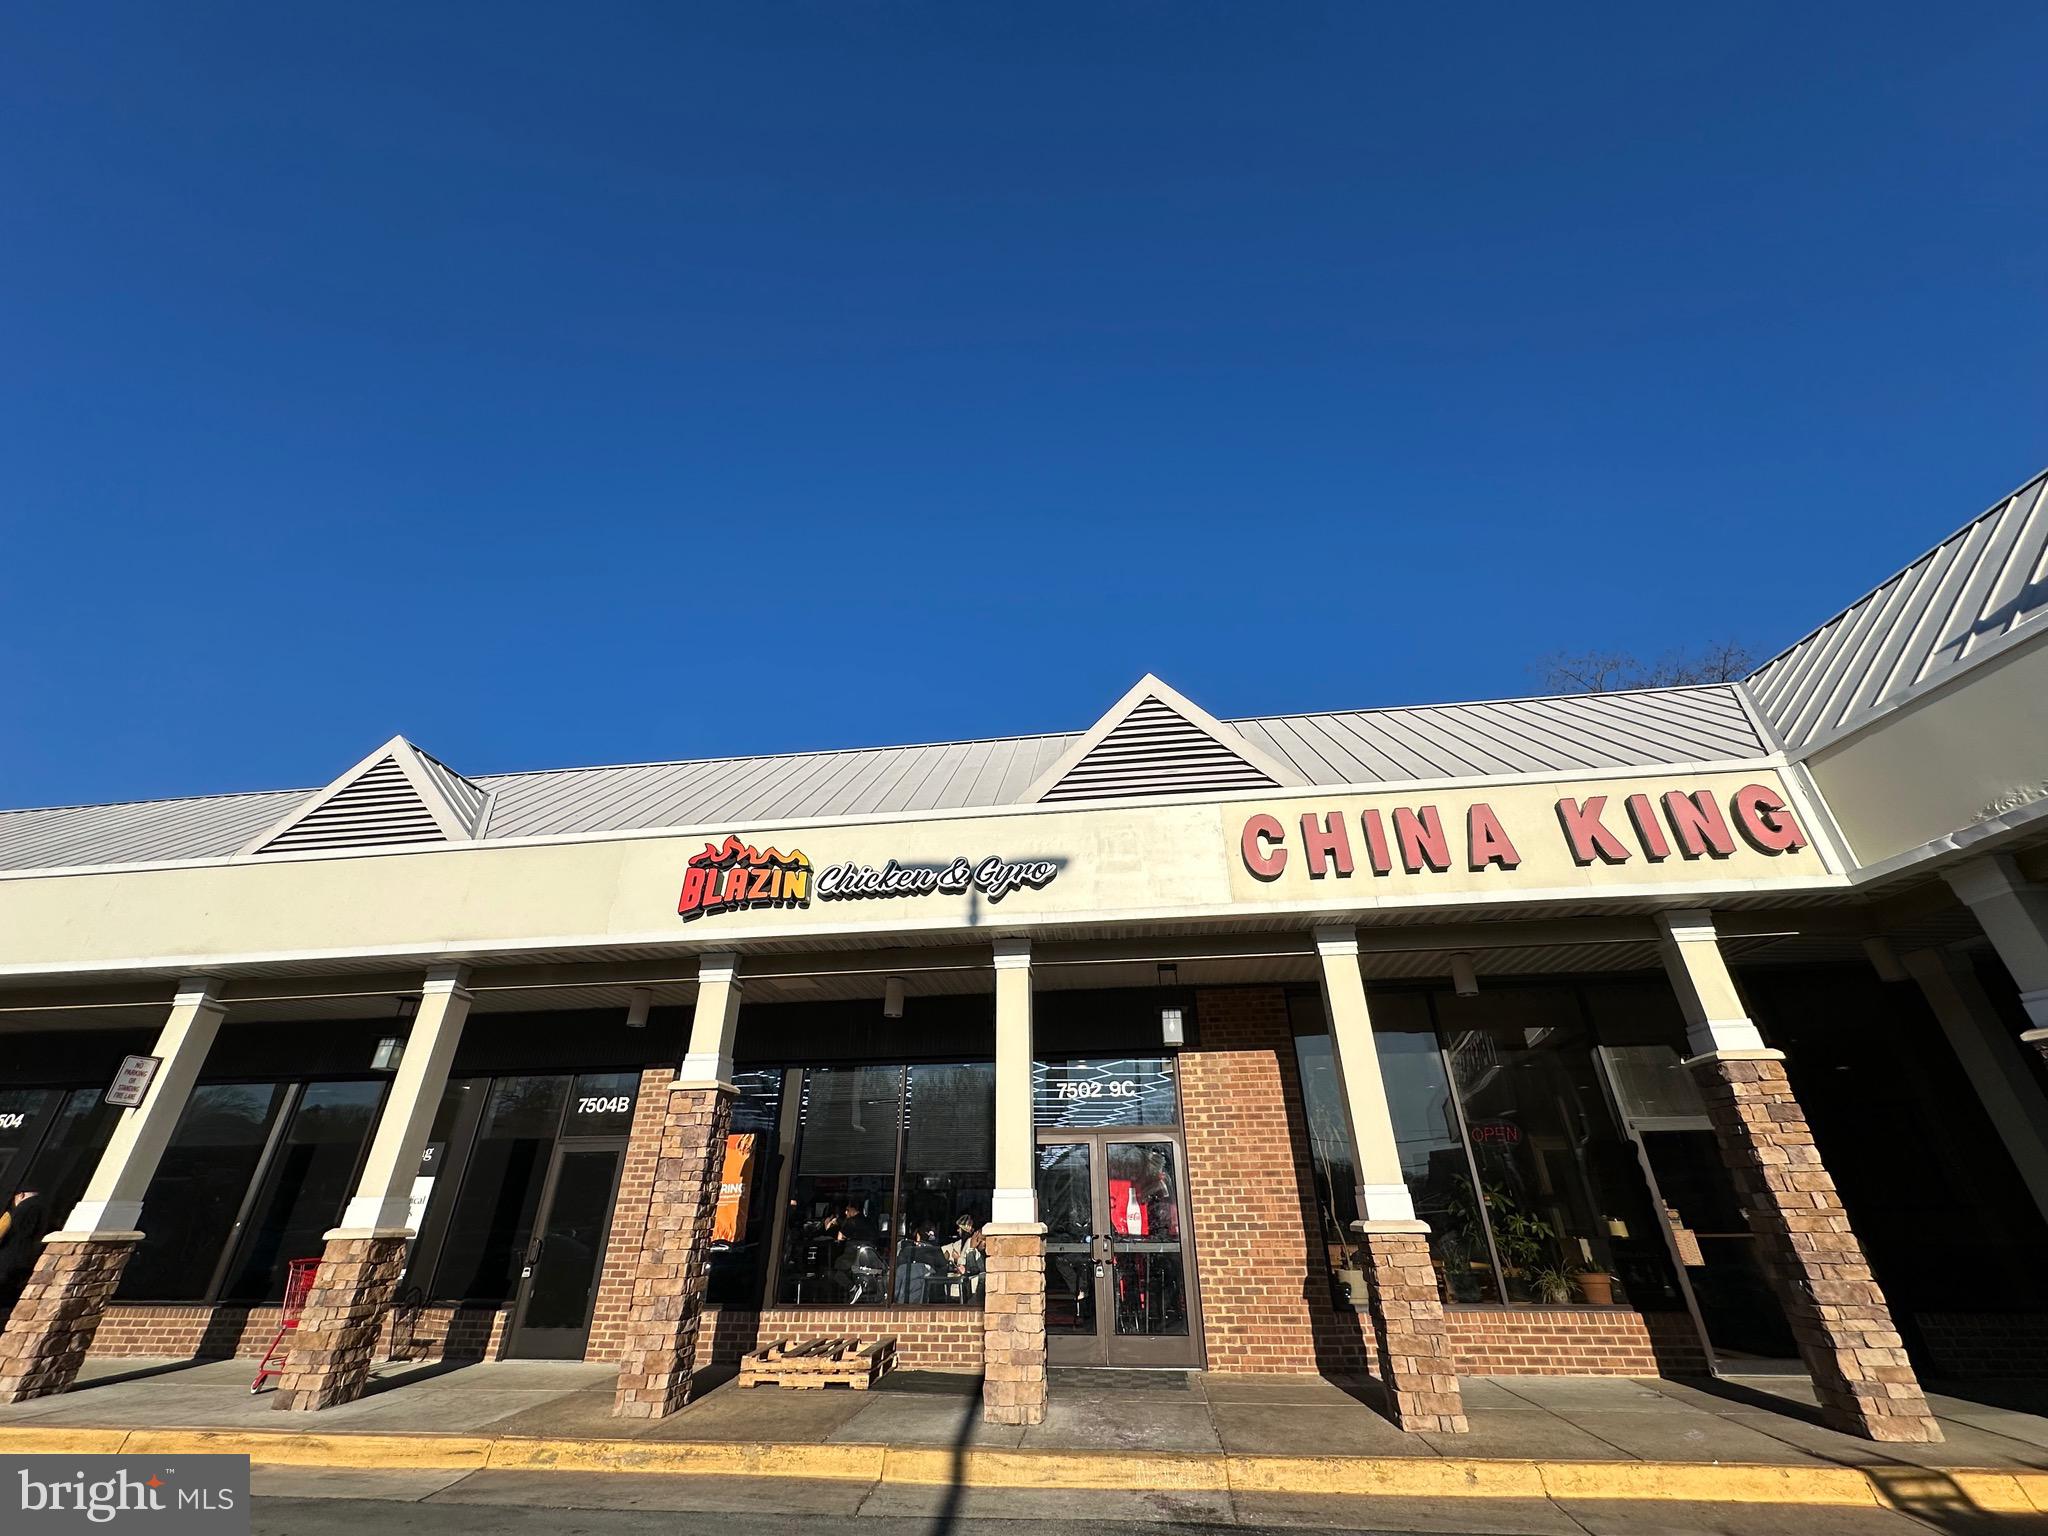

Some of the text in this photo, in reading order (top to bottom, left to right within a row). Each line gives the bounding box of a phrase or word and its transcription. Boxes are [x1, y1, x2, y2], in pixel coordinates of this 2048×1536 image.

[1241, 784, 1807, 882] CHINA KING
[677, 855, 1058, 924] BLAZIN Chicken & Gyro
[124, 1068, 148, 1077] PARKING
[1056, 1080, 1136, 1099] 7502 9C
[577, 1096, 631, 1113] 7504B
[1472, 1127, 1517, 1142] OPEN
